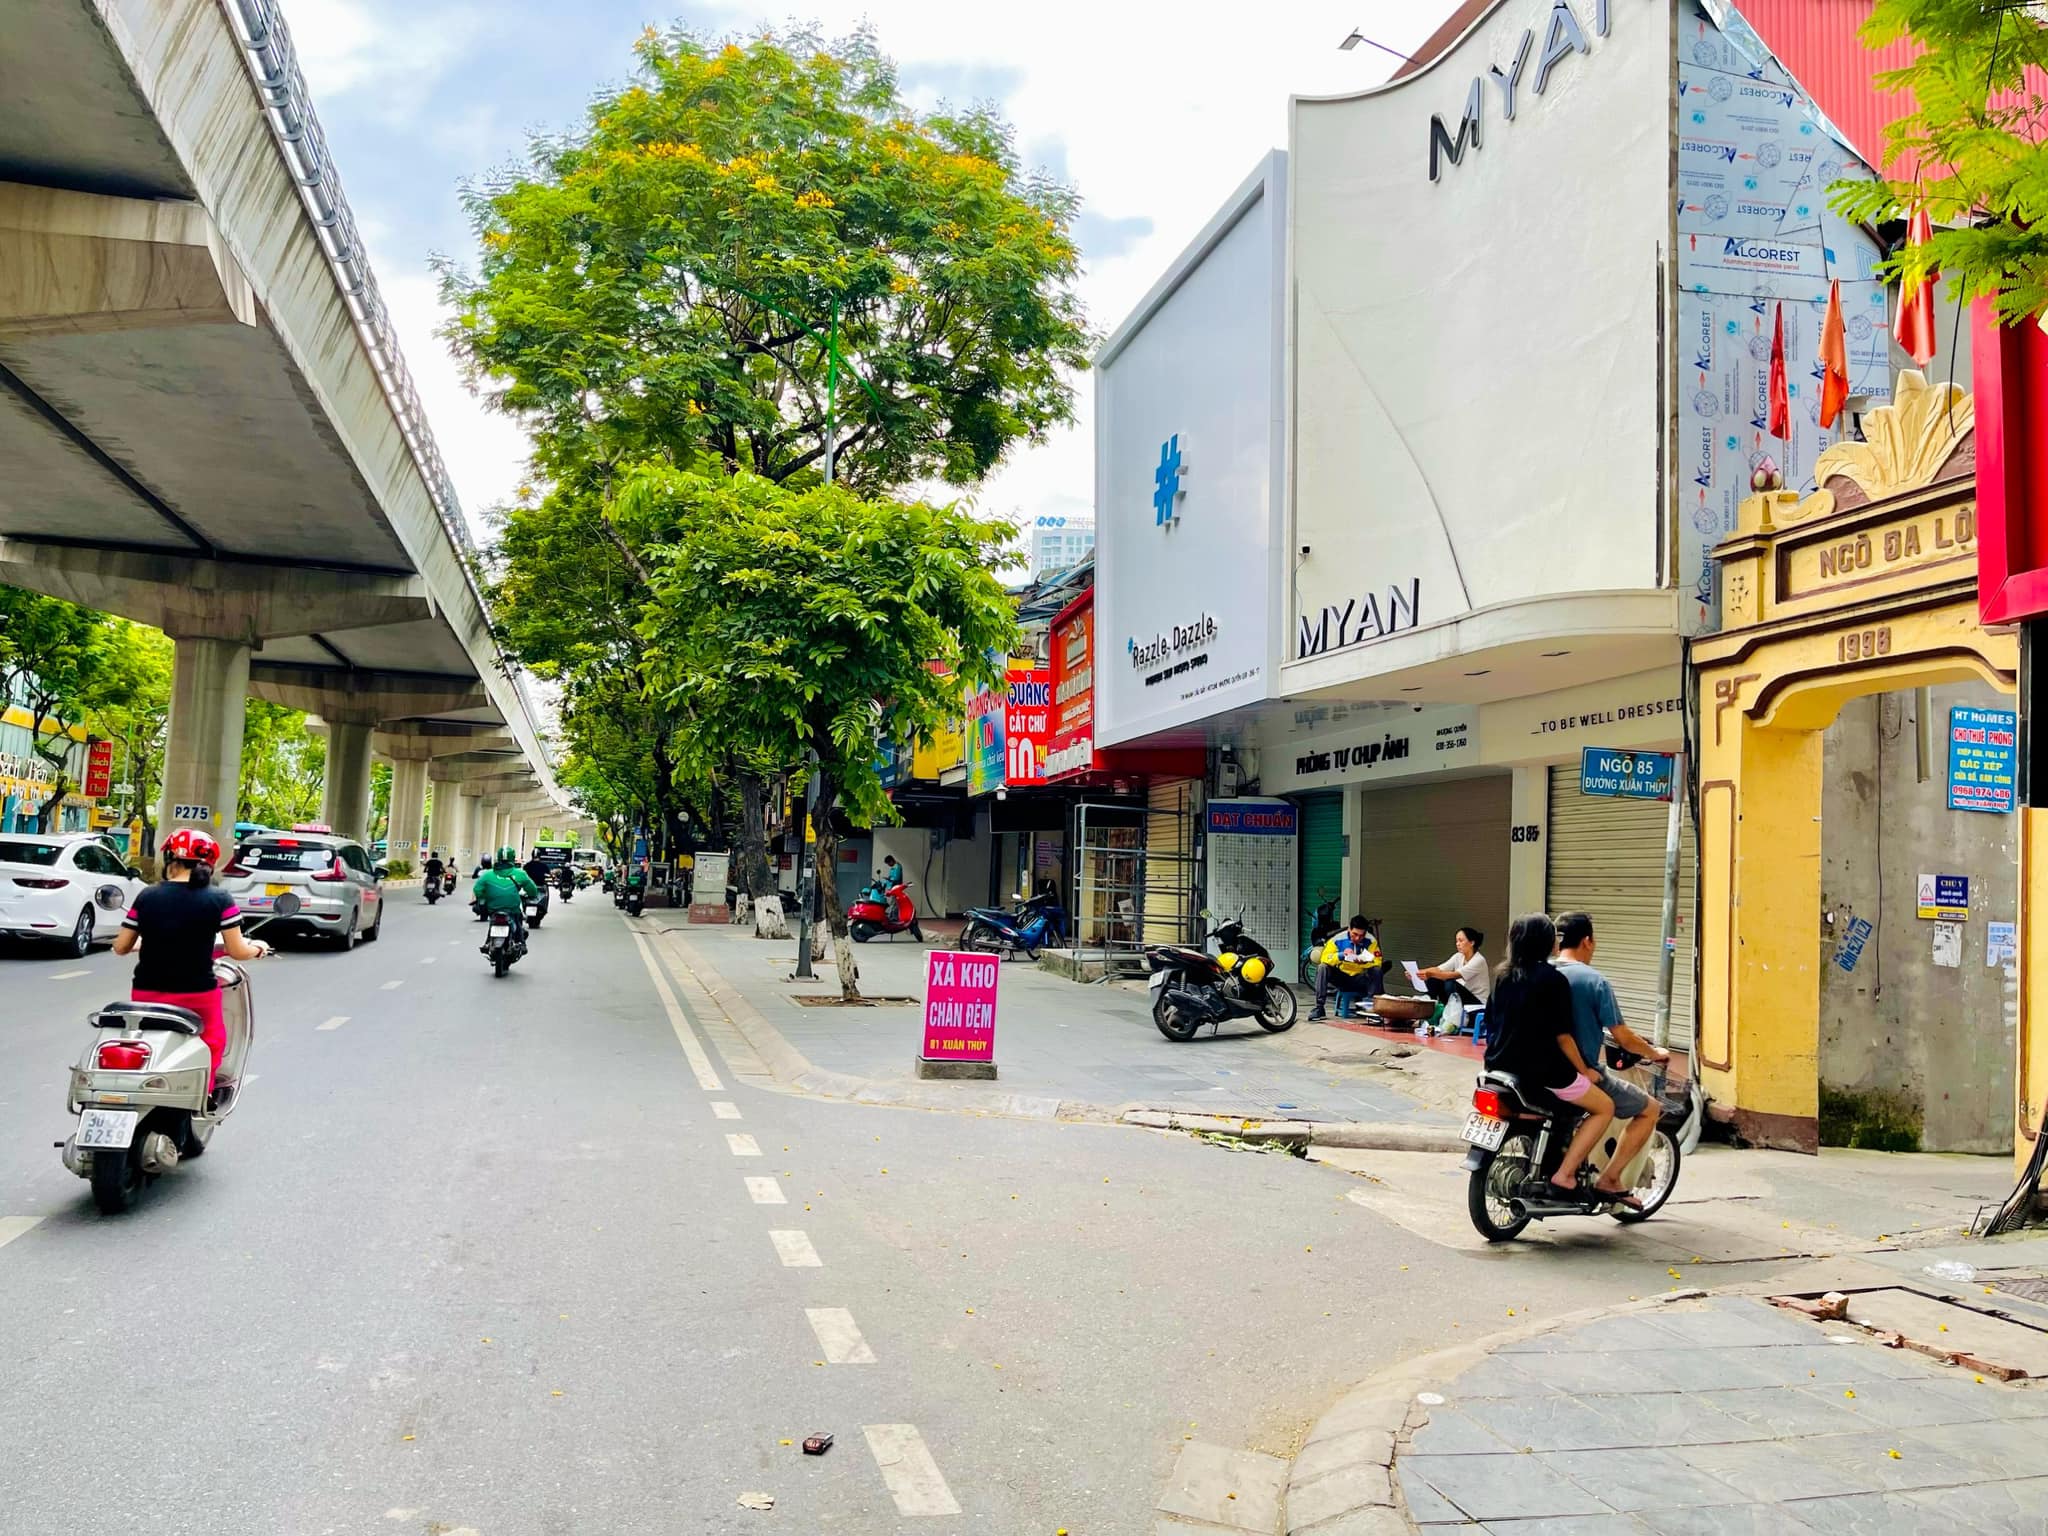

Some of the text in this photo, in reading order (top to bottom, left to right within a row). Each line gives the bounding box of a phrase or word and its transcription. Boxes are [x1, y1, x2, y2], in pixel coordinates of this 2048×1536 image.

[1723, 236, 1800, 263] ALCOREST
[1694, 311, 1711, 372] ALCOREST
[1750, 369, 1767, 430] ALCOREST
[1694, 426, 1711, 488] ALCOREST
[1934, 506, 1977, 550] LỘ
[1694, 543, 1711, 606] ALCOREST
[1297, 577, 1420, 659] MYAN
[1838, 626, 1892, 663] 1998
[1560, 716, 1576, 730] BE
[1580, 711, 1614, 727] WELL
[1618, 698, 1684, 720] DRESSED
[1955, 710, 2014, 725] HT HOMES
[1295, 734, 1409, 775] PHÒNG TỰ CHỤP ẢNH
[1600, 756, 1653, 775] NGÕ 85
[1619, 778, 1643, 792] XUÂN
[175, 806, 208, 820] P275
[1512, 827, 1525, 843] 83
[932, 953, 995, 989] XẢ KHO
[929, 997, 993, 1035] CHĂN ĐỆM
[1465, 1128, 1495, 1146] 6215
